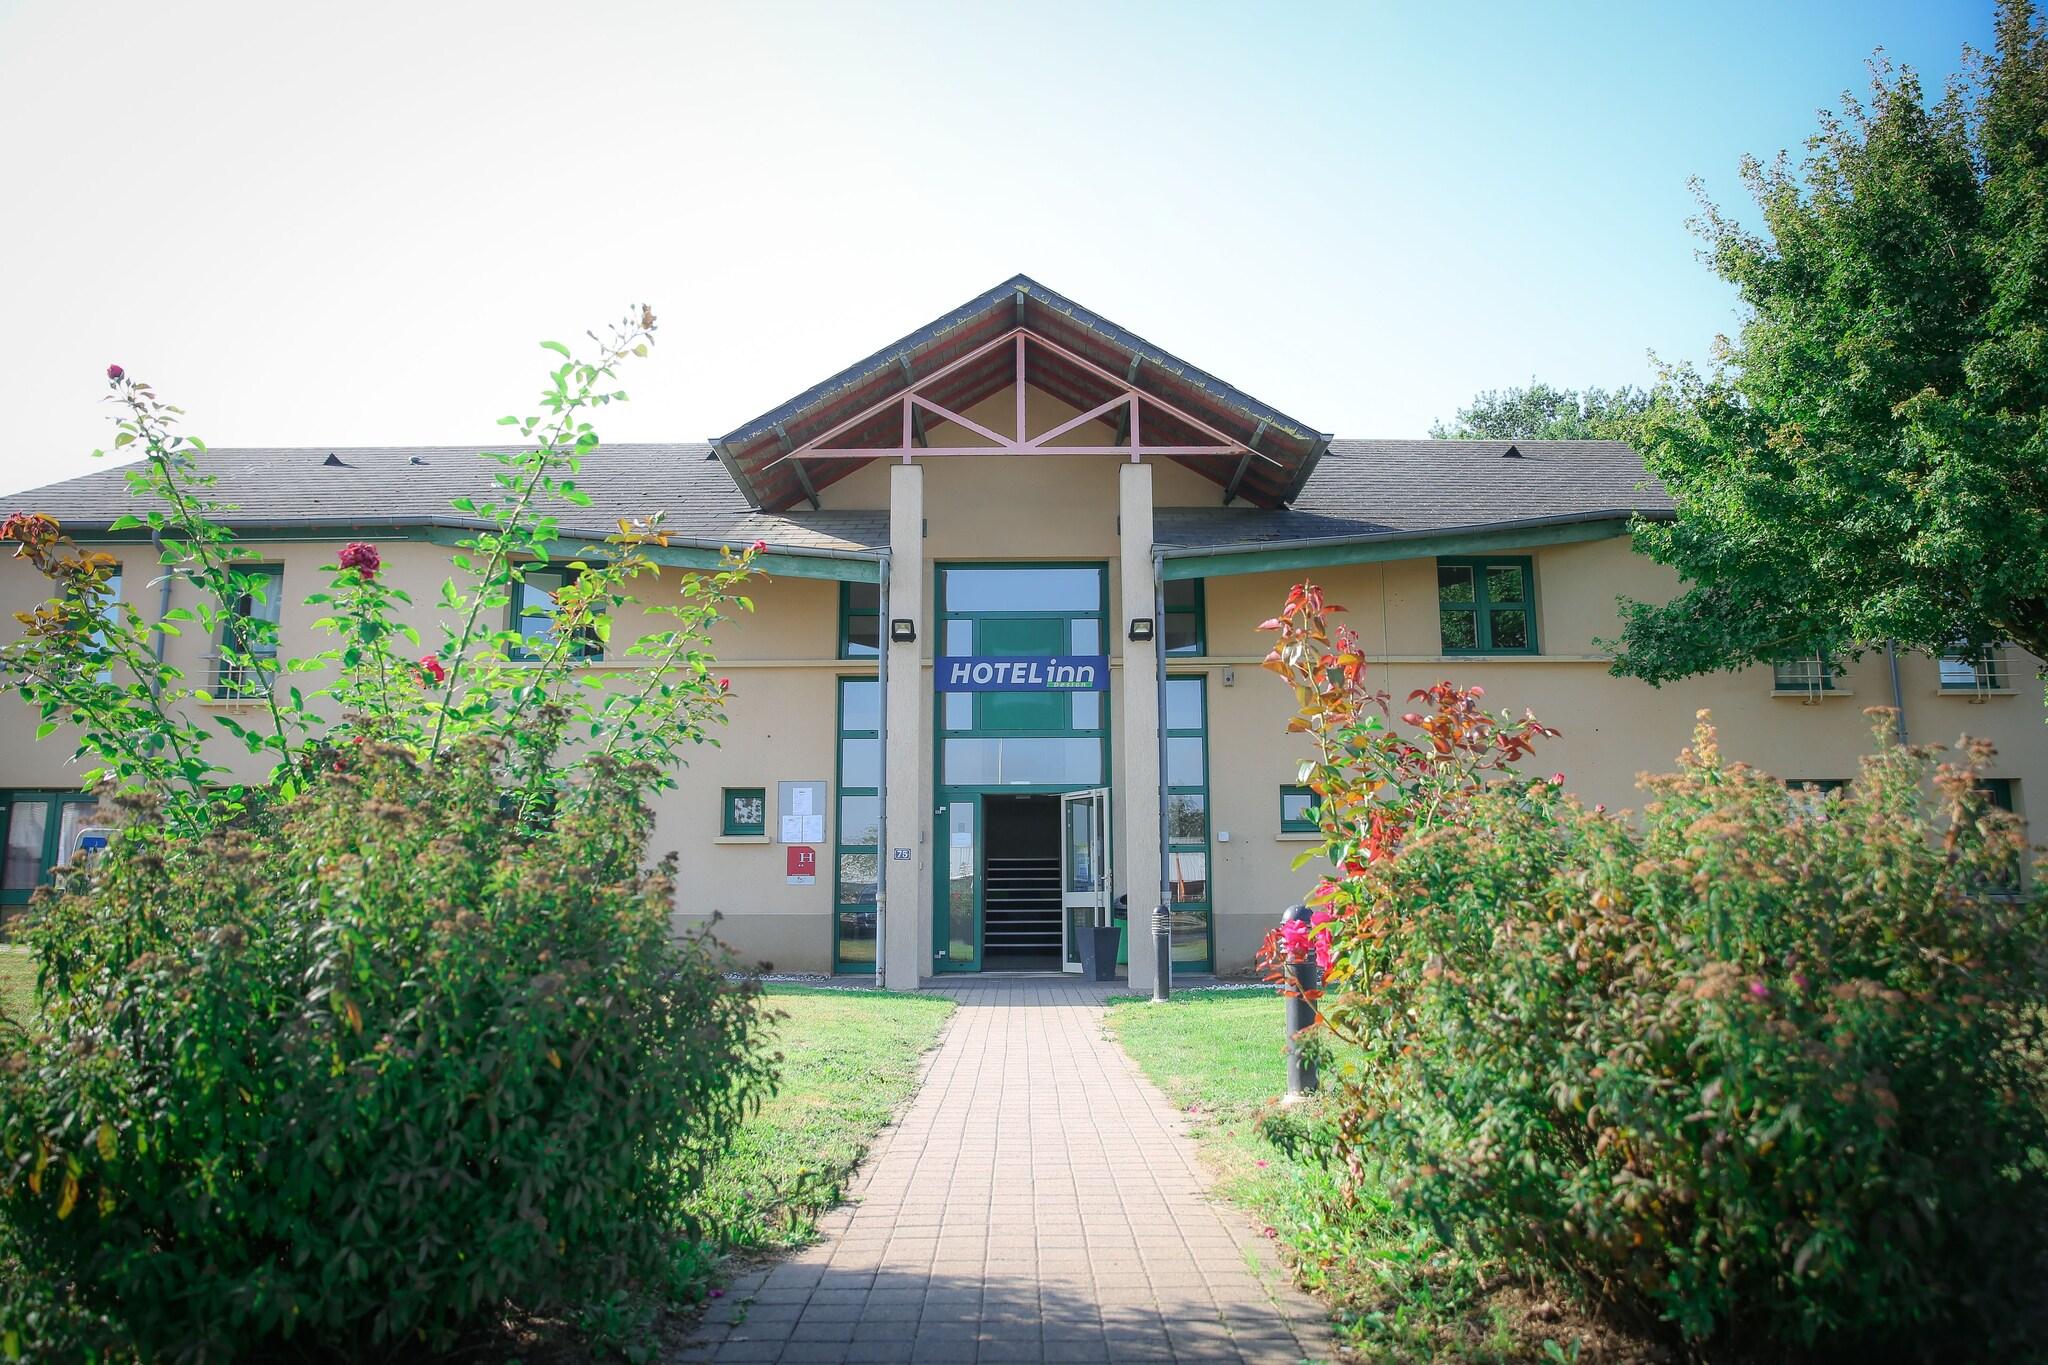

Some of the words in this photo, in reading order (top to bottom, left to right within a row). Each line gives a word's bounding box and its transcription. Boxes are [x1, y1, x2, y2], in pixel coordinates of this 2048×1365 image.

[950, 662, 1042, 684] HOTEL
[1047, 658, 1095, 682] inn
[799, 852, 814, 863] H
[896, 850, 908, 858] 75
